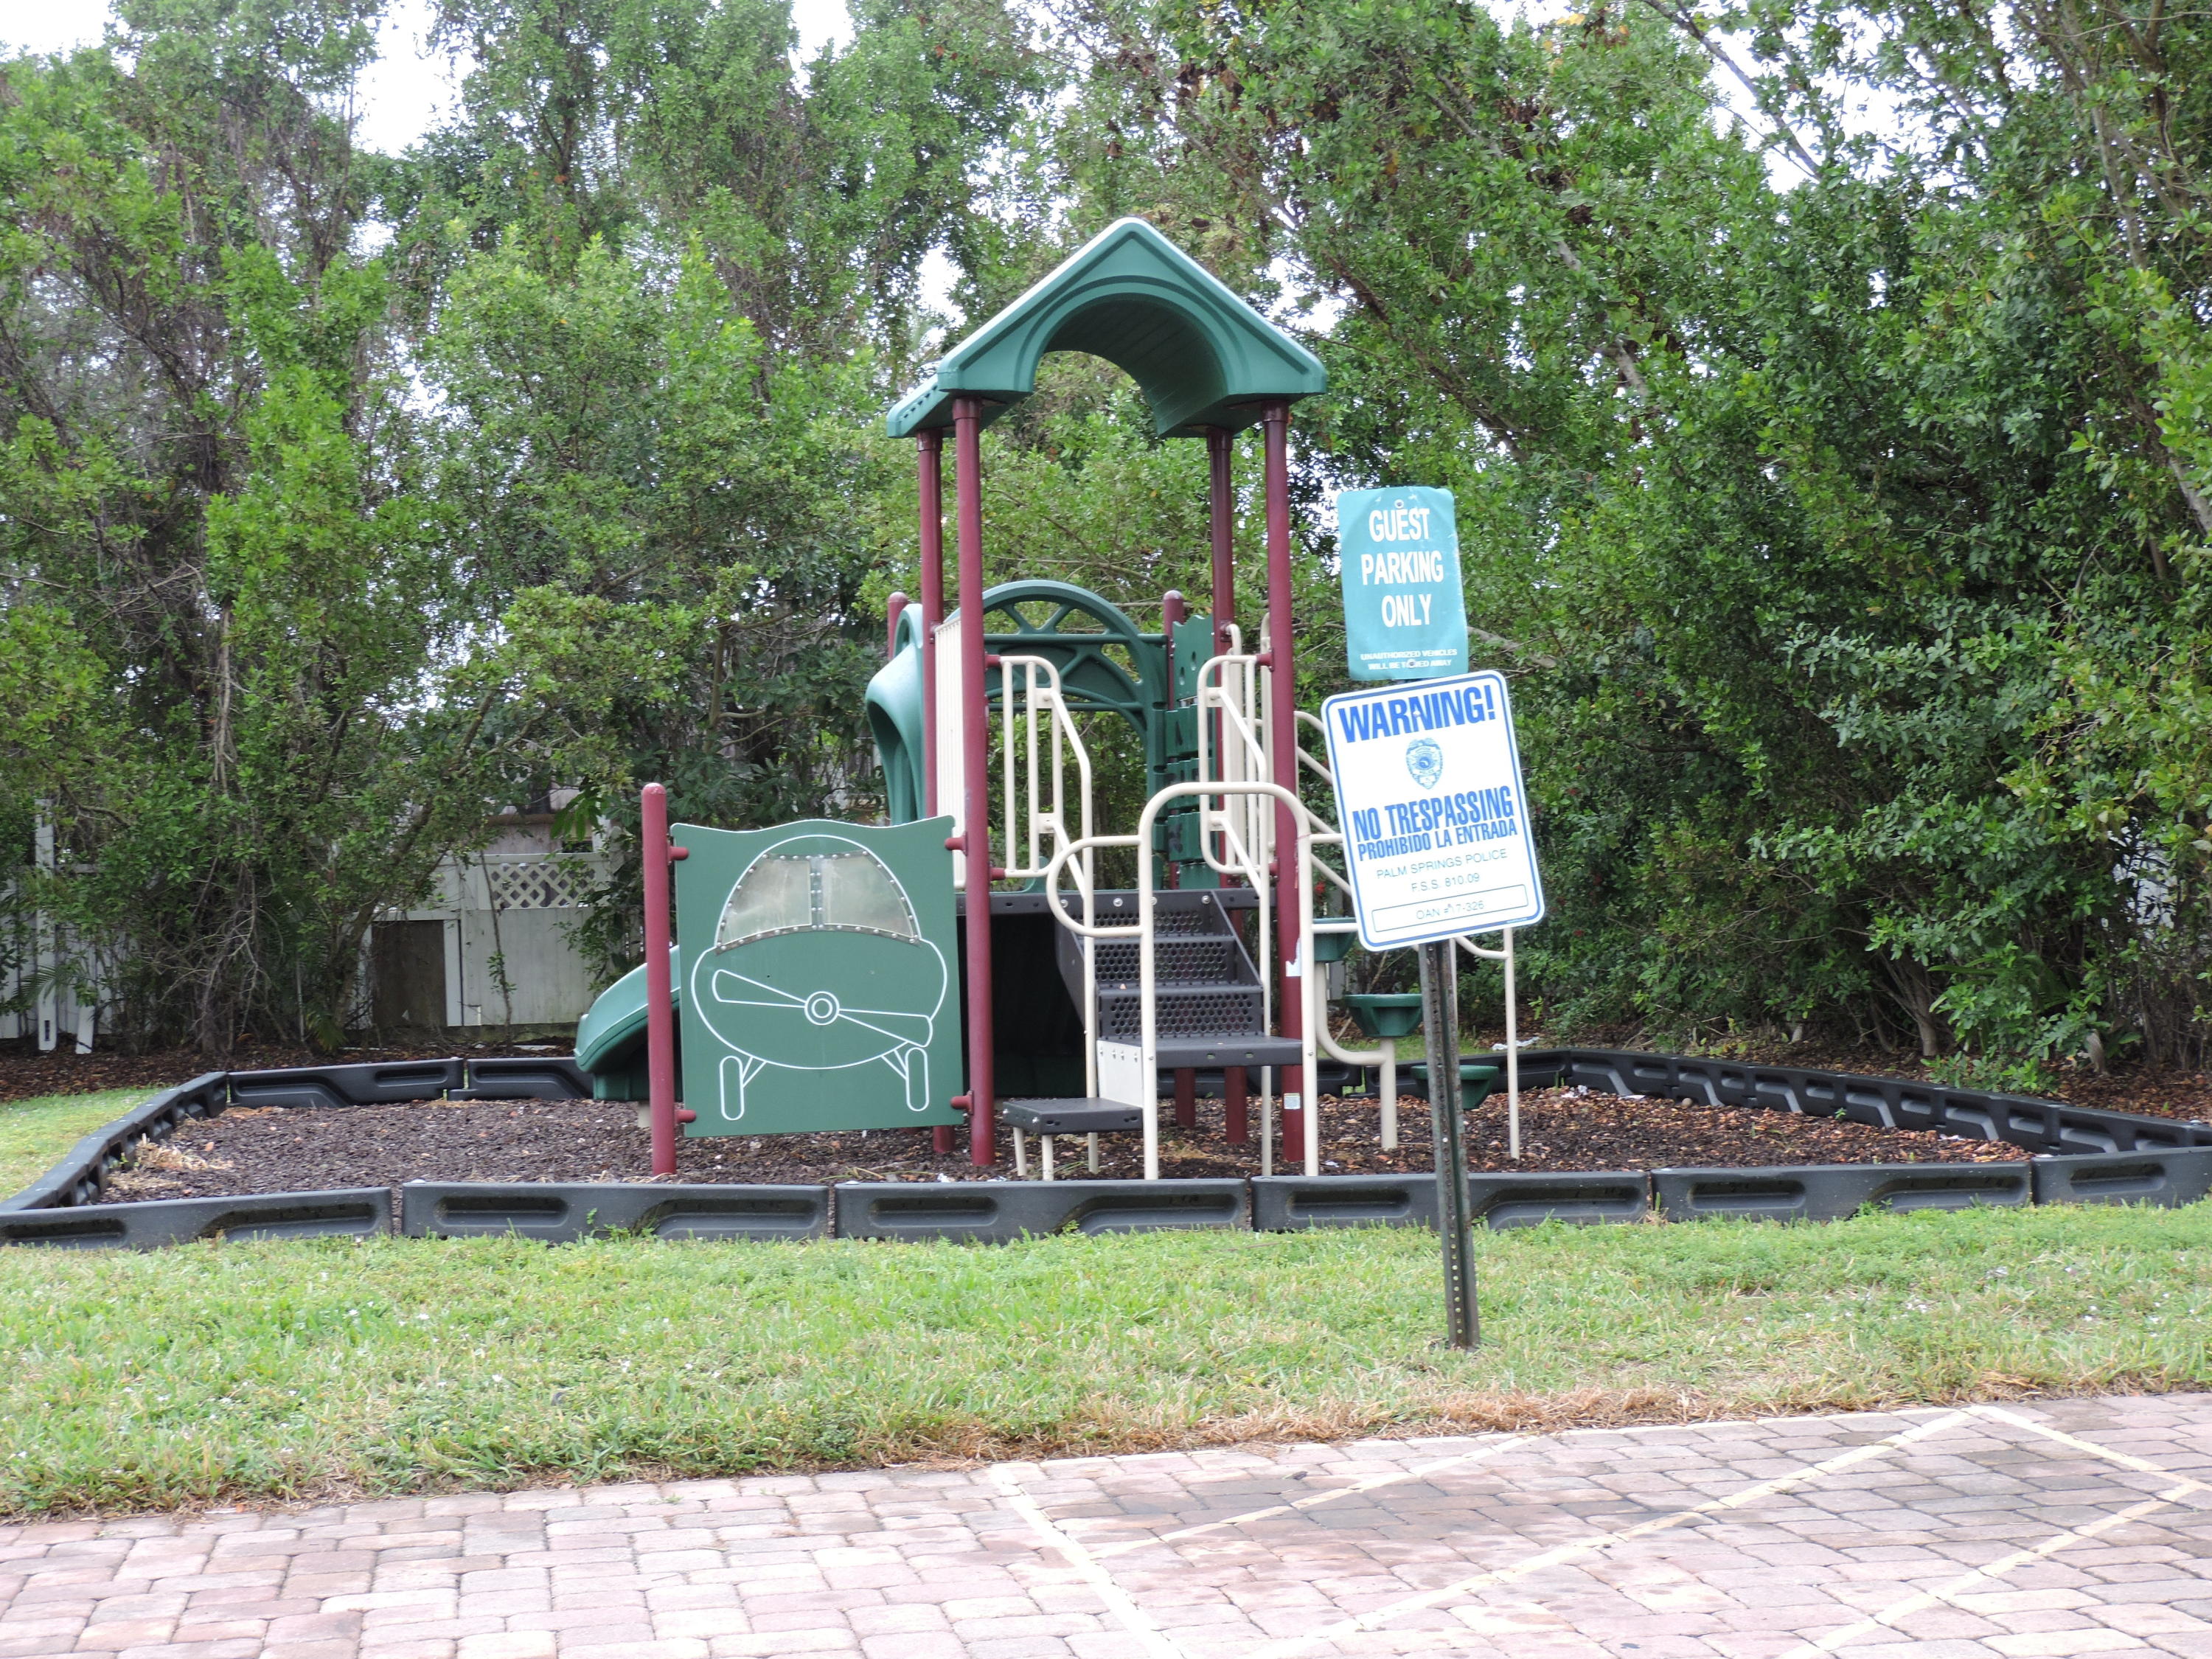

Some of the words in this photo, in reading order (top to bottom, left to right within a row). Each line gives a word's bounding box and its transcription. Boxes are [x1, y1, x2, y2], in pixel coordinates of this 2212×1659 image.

[1369, 508, 1430, 542] GUEST
[1361, 550, 1444, 585] PARKING
[1382, 594, 1431, 627] ONLY
[1360, 650, 1421, 660] UNAUTHORIZED
[1422, 649, 1457, 657] VEHICLES
[1401, 660, 1429, 669] TED
[1338, 685, 1495, 743] WARNING!
[1352, 807, 1382, 842] NO
[1384, 785, 1514, 836] TRESPASSING
[1357, 832, 1431, 861] PROHIBIDO
[1436, 829, 1453, 848] LA
[1455, 818, 1517, 845] ENTRADA
[1377, 866, 1407, 879] PALM
[1411, 856, 1462, 874] SPRINGS
[1466, 849, 1507, 864] POLICE
[1444, 872, 1480, 887] 810.09
